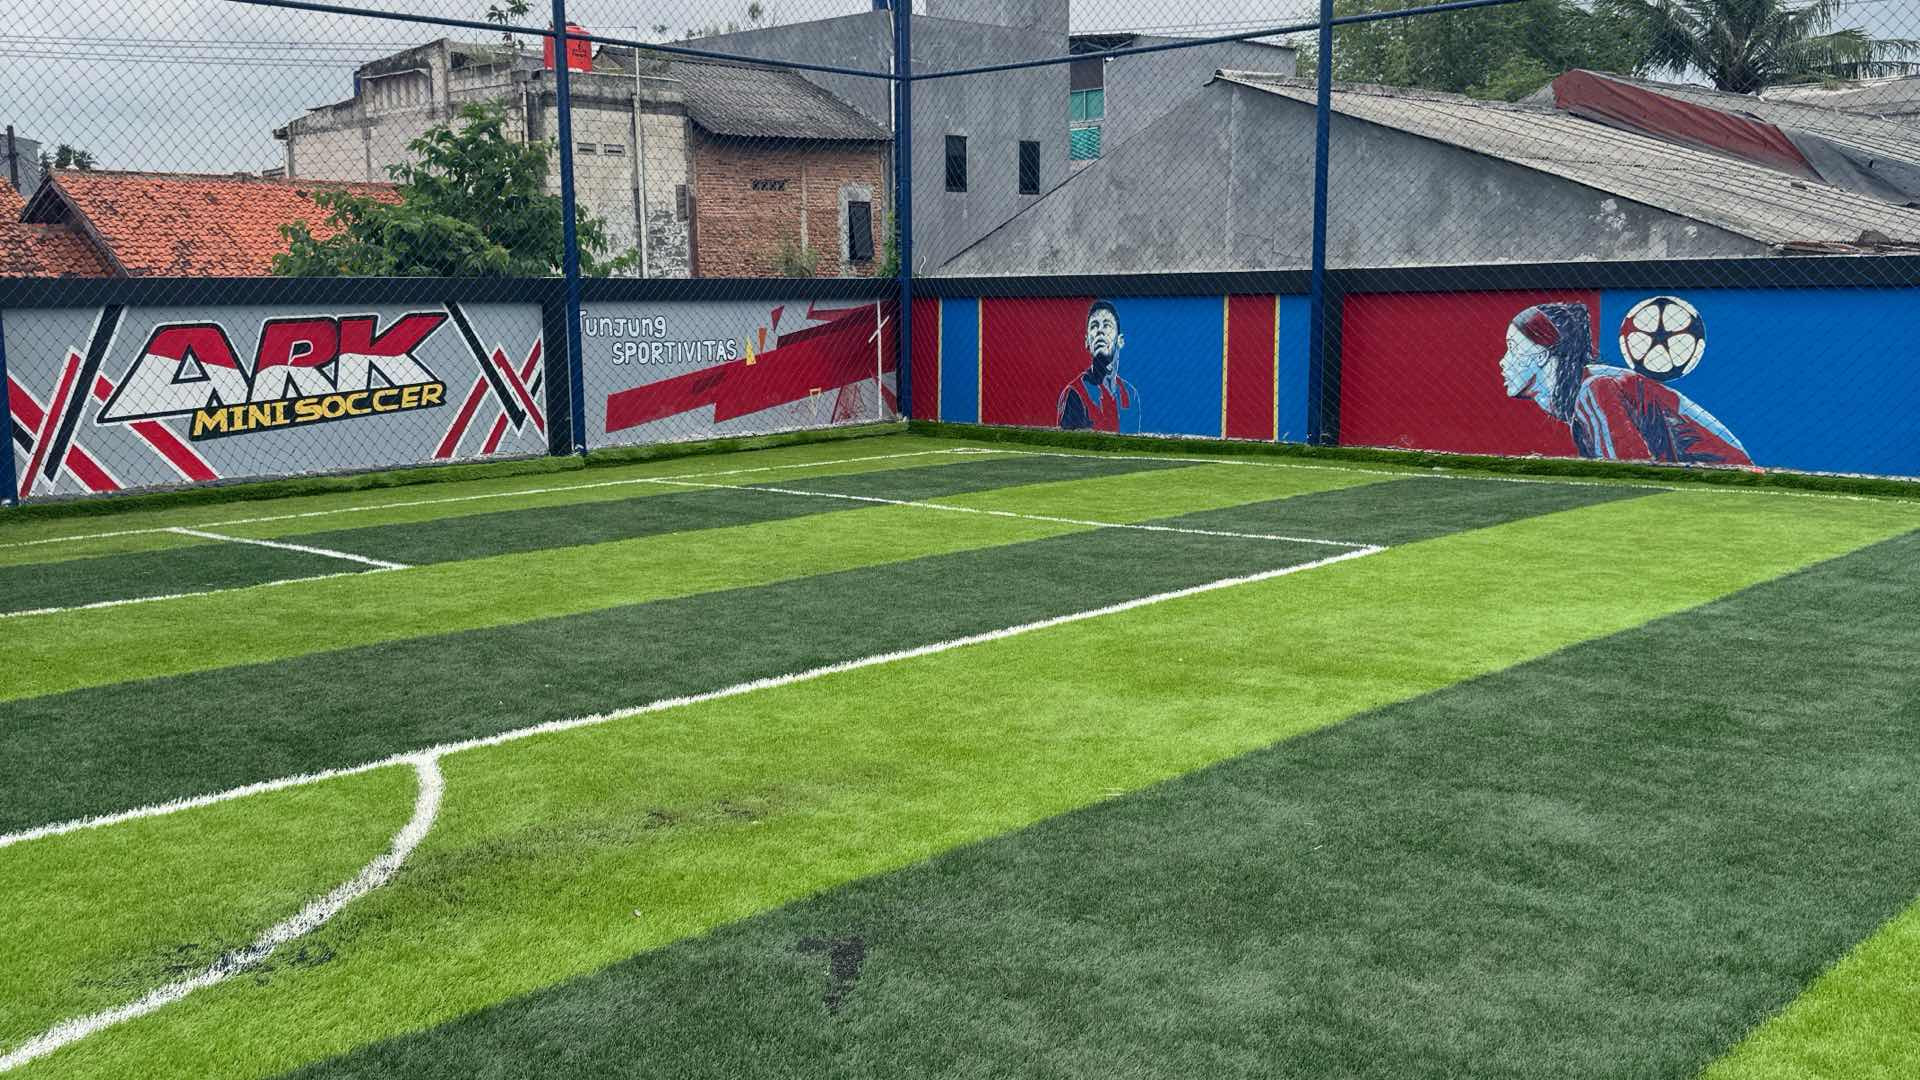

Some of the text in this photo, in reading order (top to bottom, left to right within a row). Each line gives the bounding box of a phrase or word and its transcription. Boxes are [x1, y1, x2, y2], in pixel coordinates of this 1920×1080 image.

[98, 312, 450, 423] ARK
[612, 339, 738, 366] SPORTIVITAS
[192, 383, 444, 437] MINI SOCCER
